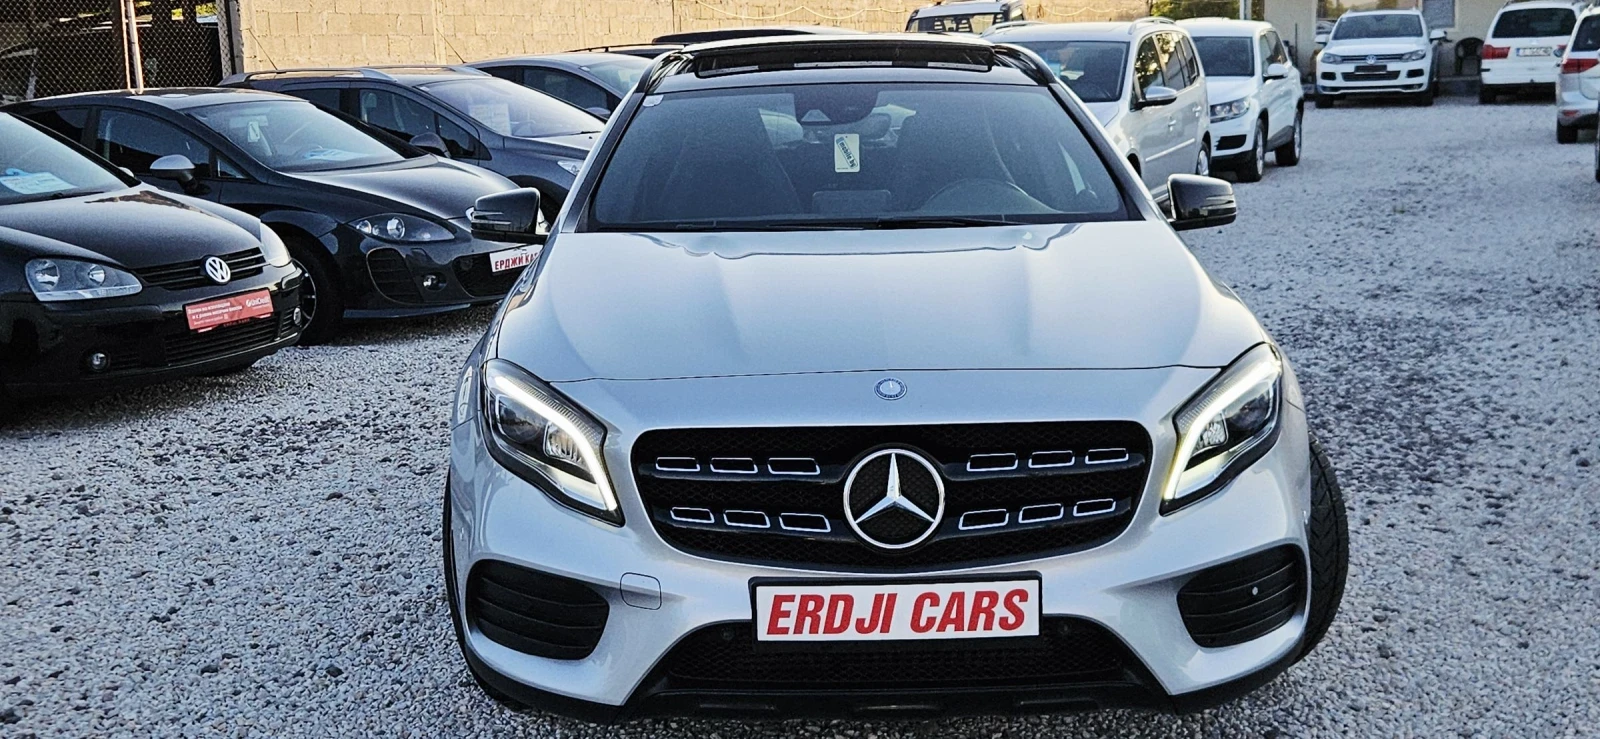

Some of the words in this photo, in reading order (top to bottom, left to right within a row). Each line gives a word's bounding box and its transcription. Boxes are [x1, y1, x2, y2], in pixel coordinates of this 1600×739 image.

[495, 256, 523, 270] ЕРДЖИ
[766, 592, 898, 635] ERDJI
[910, 588, 1029, 634] CARS
